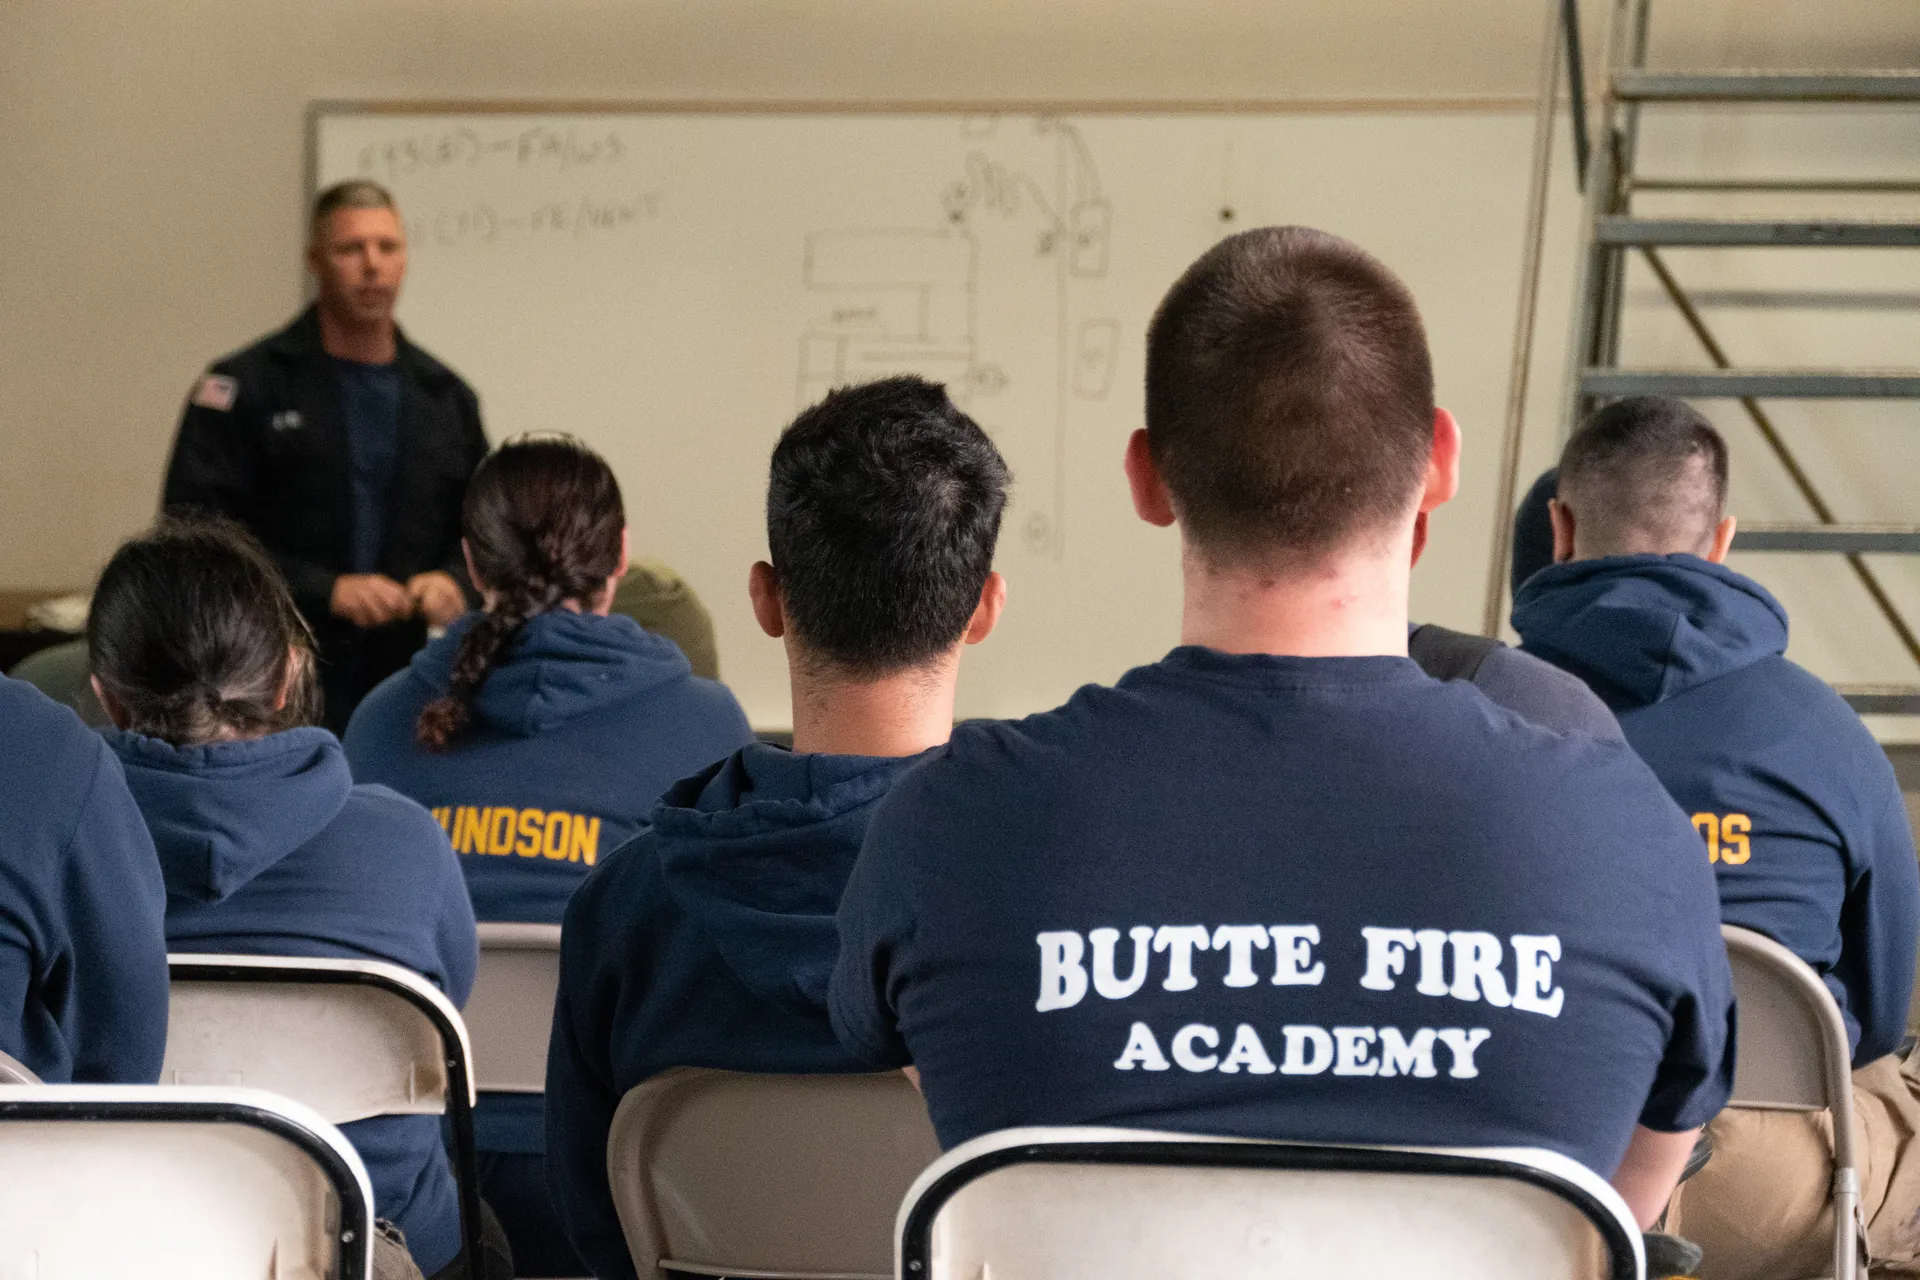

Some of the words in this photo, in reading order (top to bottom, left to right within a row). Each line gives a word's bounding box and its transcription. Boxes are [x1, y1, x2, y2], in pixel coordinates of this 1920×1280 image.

[431, 806, 601, 866] UNDSON
[1035, 924, 1325, 1012] BUTTE
[1360, 926, 1565, 1019] FIRE
[1113, 1021, 1491, 1079] ACADEMY
